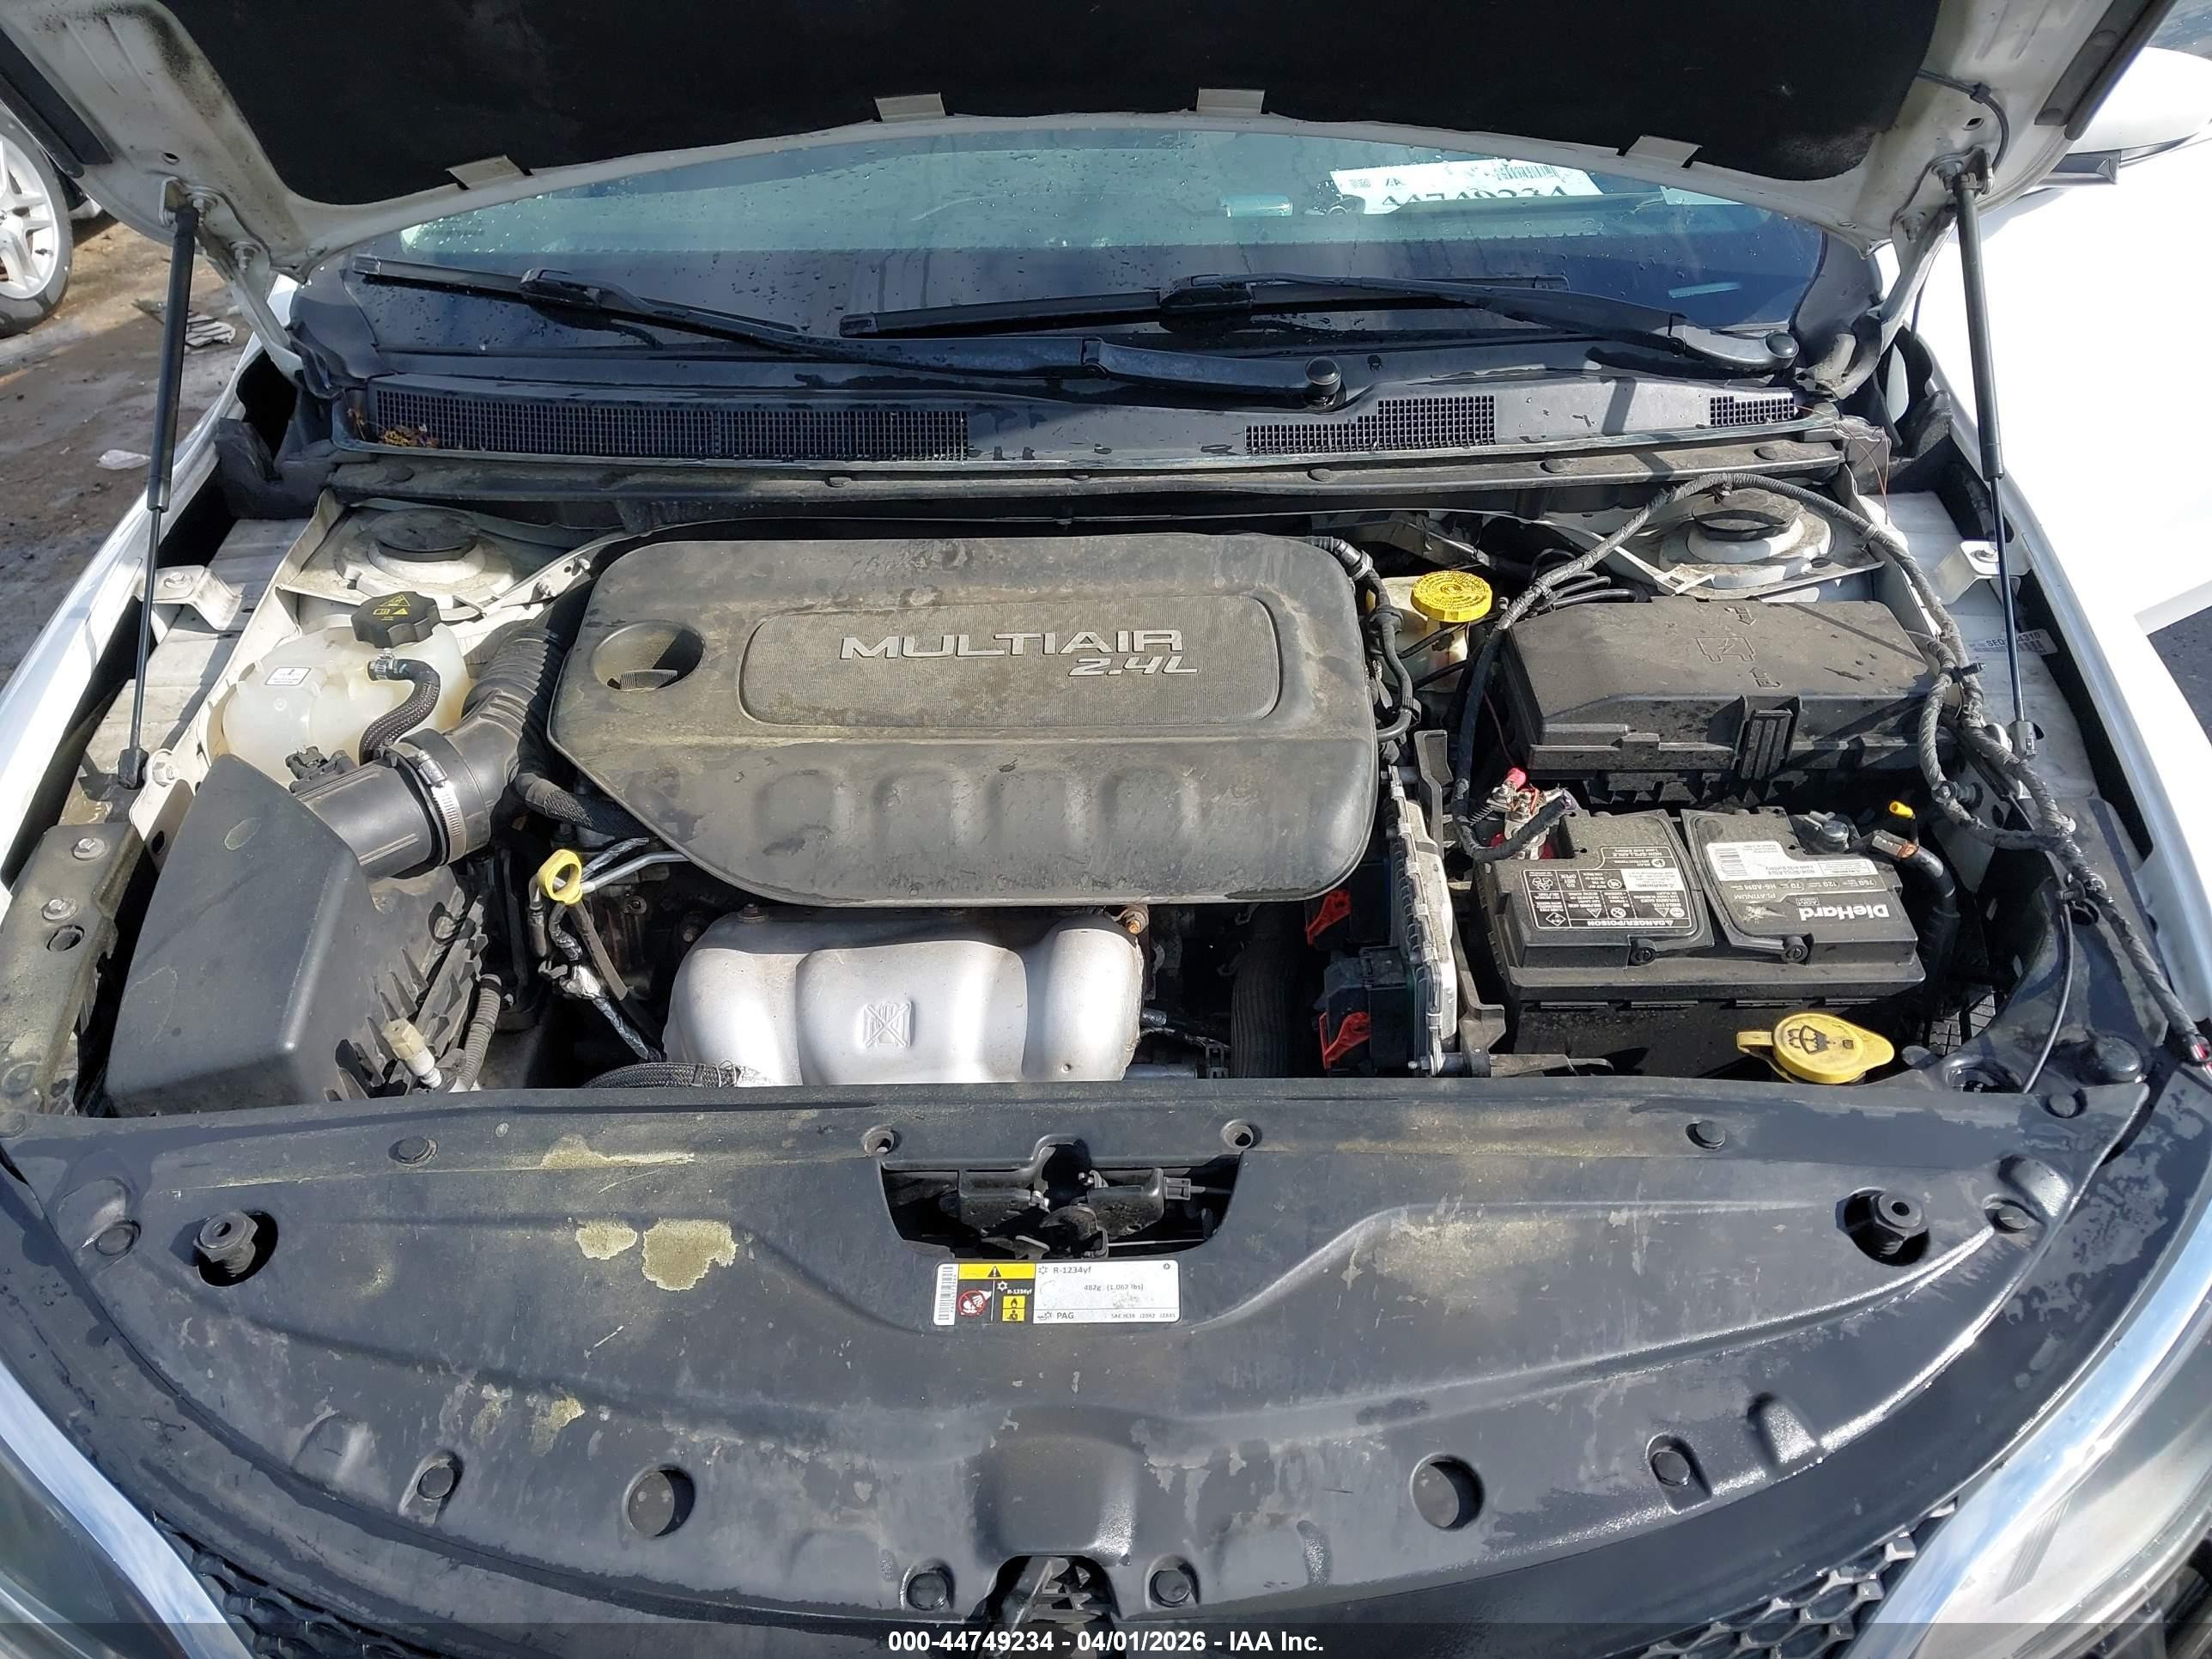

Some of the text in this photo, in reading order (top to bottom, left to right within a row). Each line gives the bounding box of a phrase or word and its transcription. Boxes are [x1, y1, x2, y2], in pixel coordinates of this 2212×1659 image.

[840, 629, 1183, 660] MULTIAIR
[1068, 655, 1198, 678] 2.4L
[1799, 904, 1889, 921] DieHard
[1053, 1266, 1091, 1275] R-1234yf
